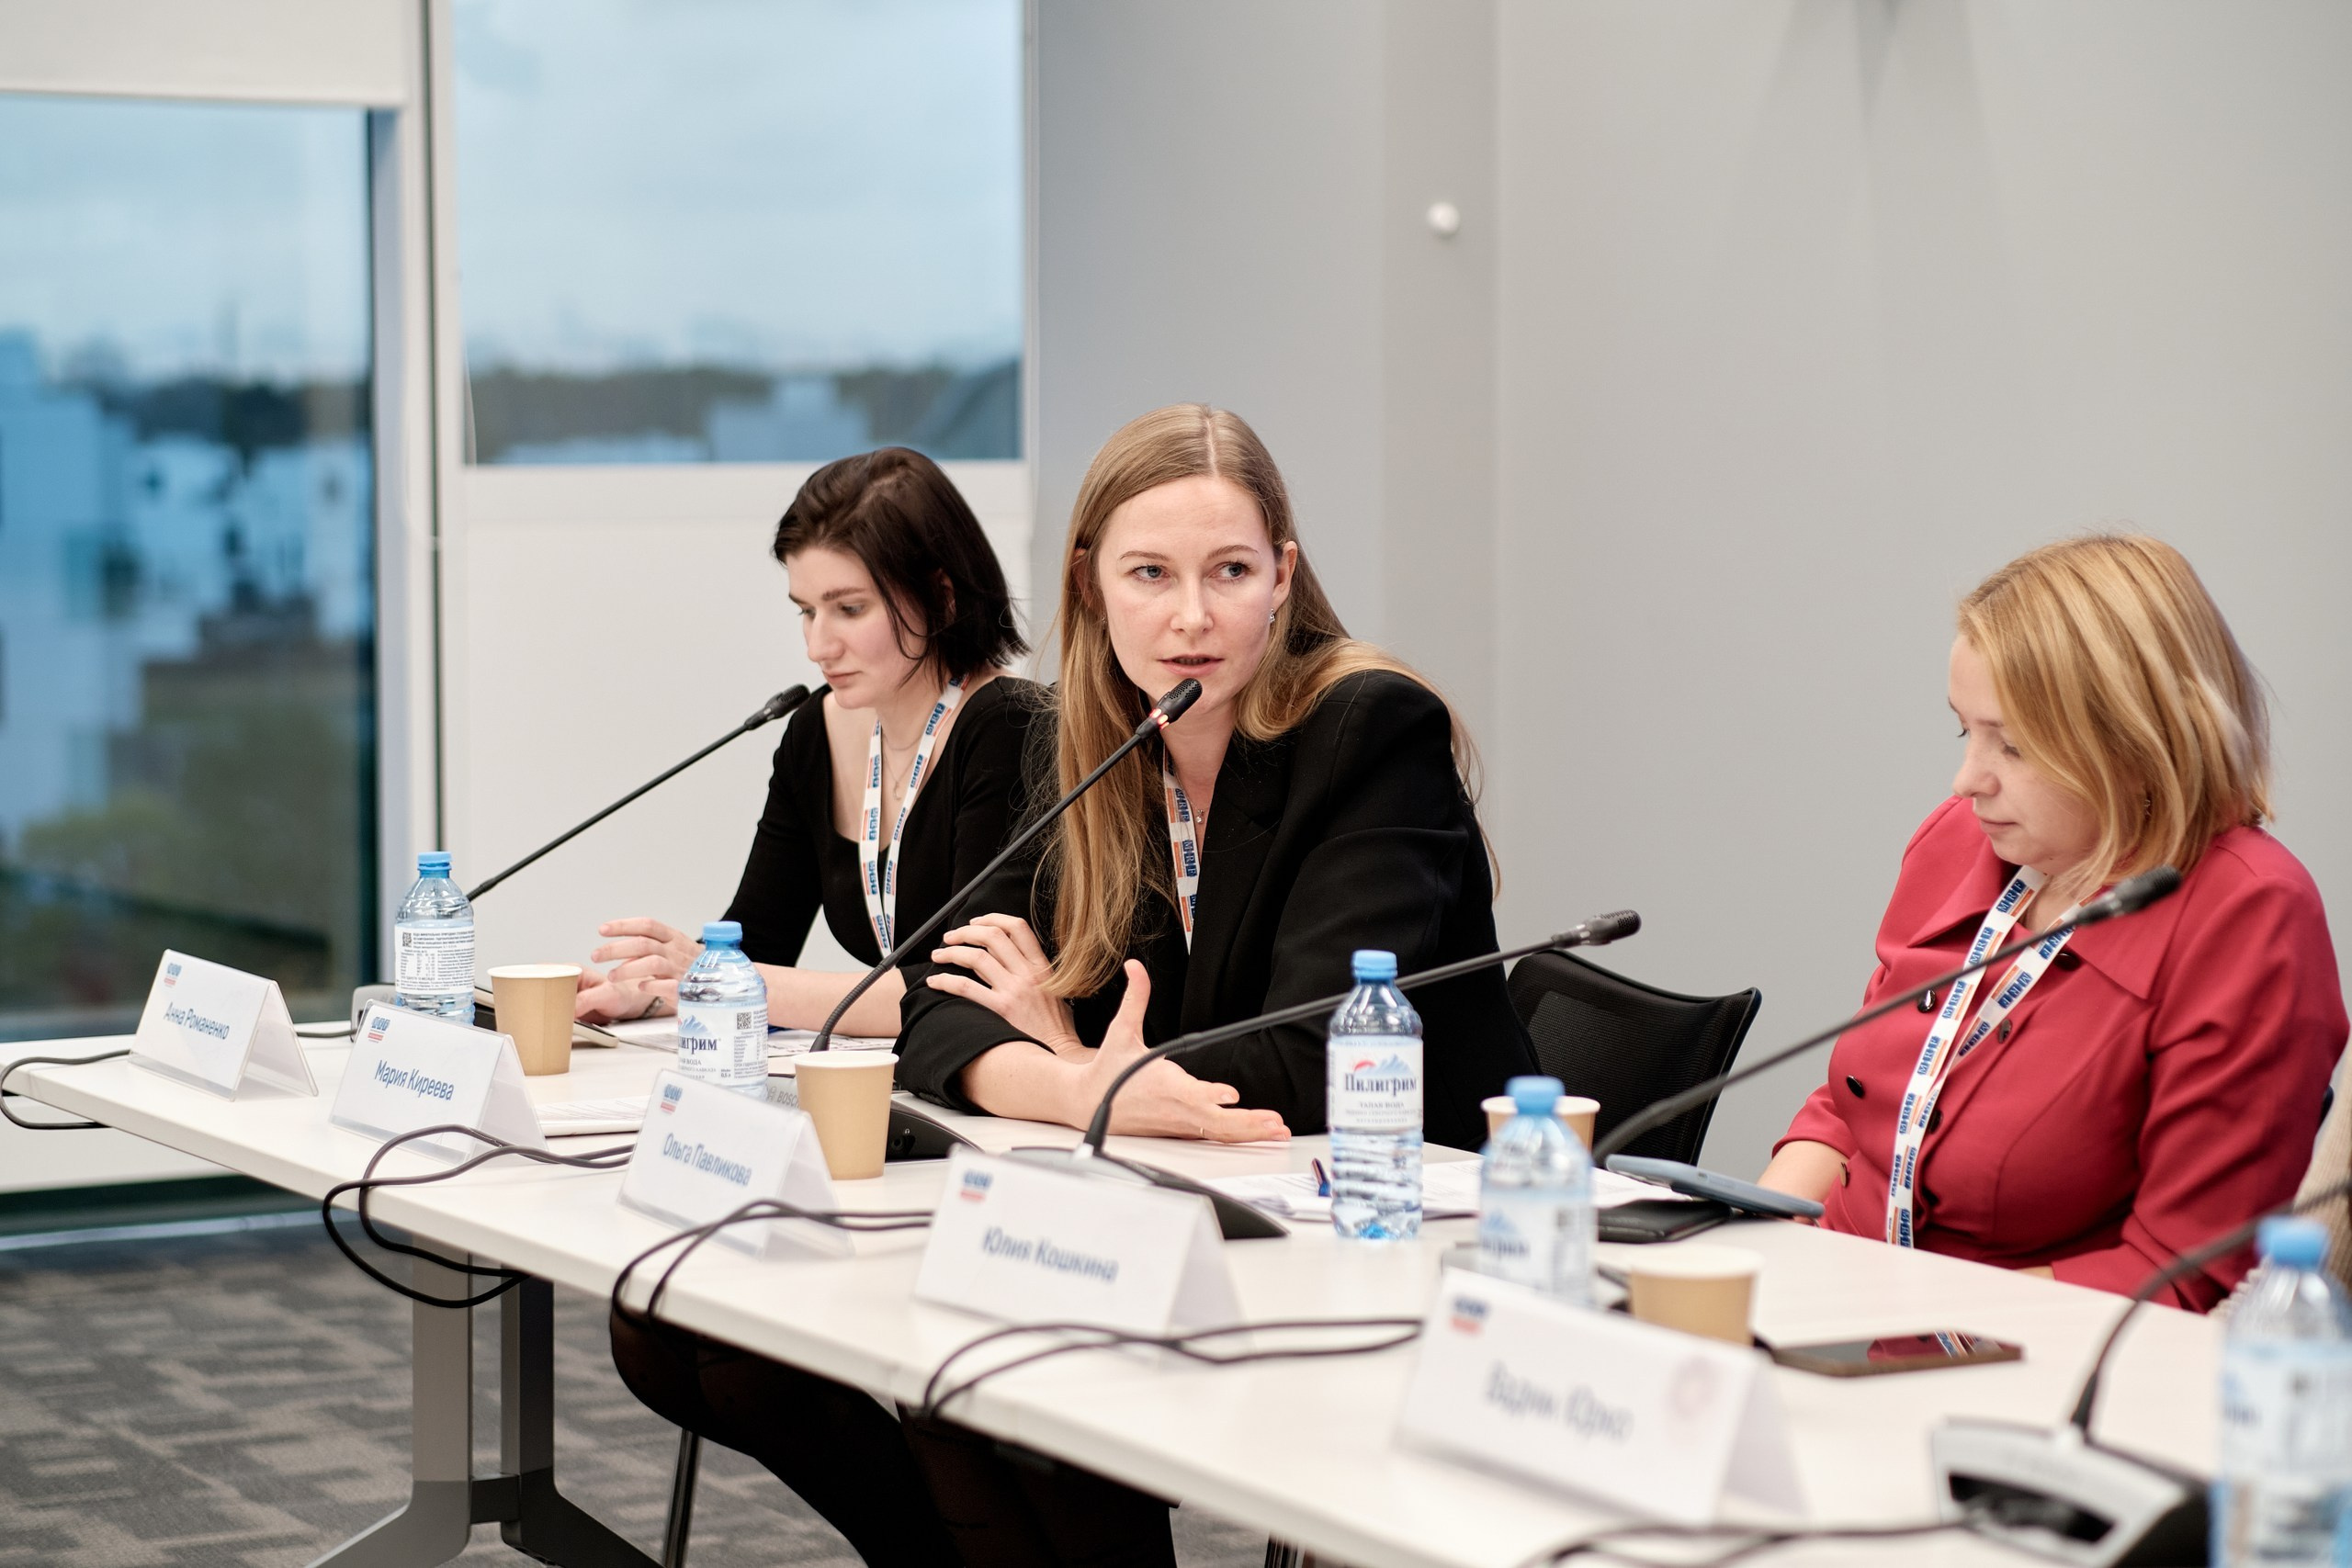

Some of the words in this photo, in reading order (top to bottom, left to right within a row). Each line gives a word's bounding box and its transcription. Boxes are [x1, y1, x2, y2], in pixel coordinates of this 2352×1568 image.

[1182, 840, 1198, 877] MRF
[1996, 878, 2027, 913] MRF
[1969, 927, 1995, 964] MRF
[1941, 981, 1967, 1019] MRF
[164, 1001, 186, 1025] Анна
[184, 1009, 230, 1040] Романенко
[374, 1059, 408, 1089] Мария
[407, 1068, 455, 1101] Киреева
[1344, 1072, 1418, 1097] Пилигрим
[662, 1132, 693, 1164] Ольга
[691, 1143, 752, 1187] Павликова
[983, 1226, 1033, 1261] Юлия
[1035, 1239, 1120, 1282] Кошкина
